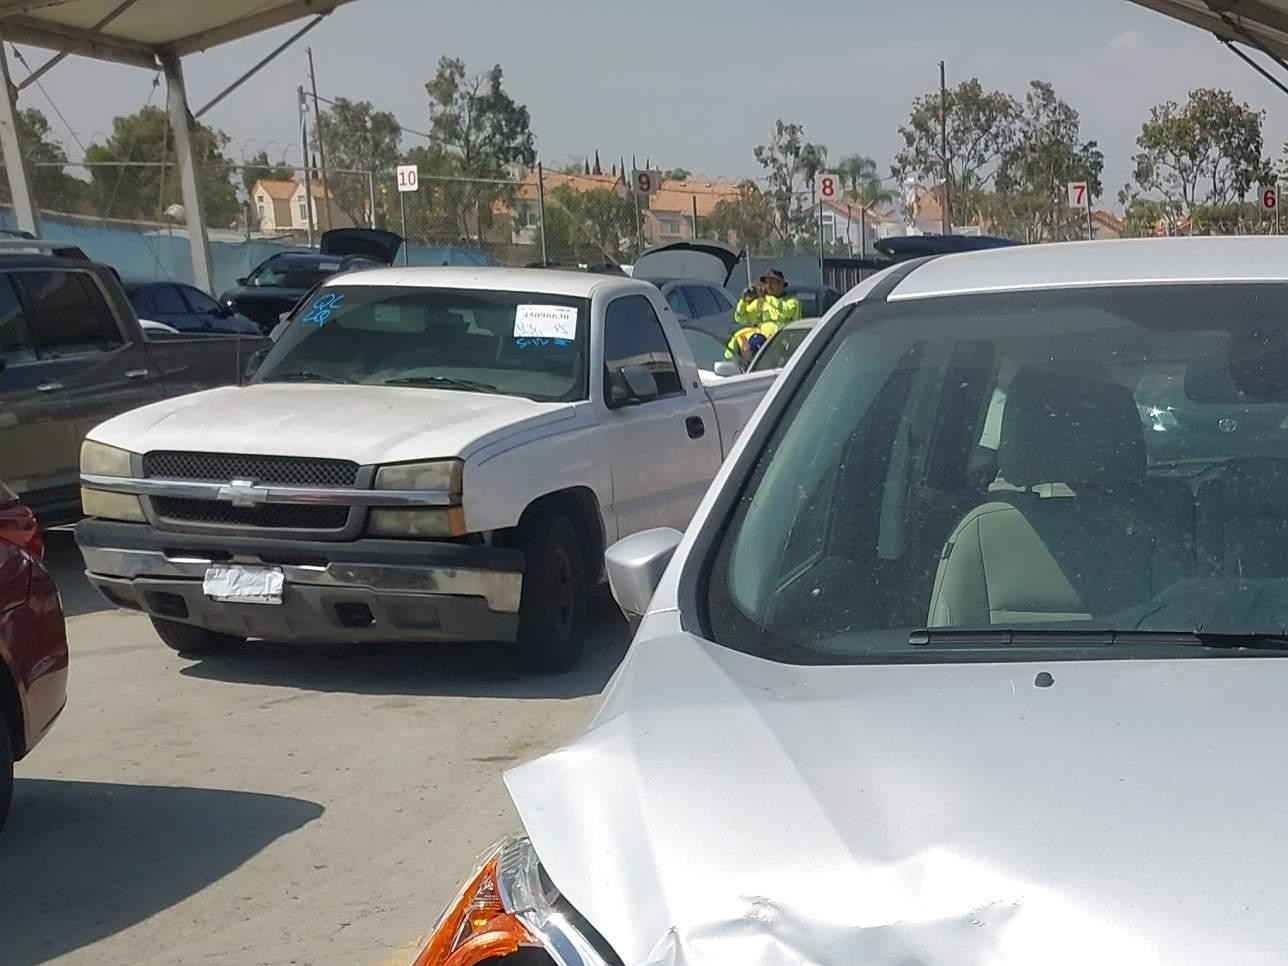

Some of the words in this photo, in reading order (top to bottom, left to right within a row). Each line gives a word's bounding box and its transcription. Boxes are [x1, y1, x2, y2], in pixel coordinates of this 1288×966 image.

[399, 170, 416, 186] 10
[638, 173, 651, 192] 9
[822, 178, 835, 197] 8
[1073, 185, 1086, 205] 7
[1263, 190, 1276, 208] 6
